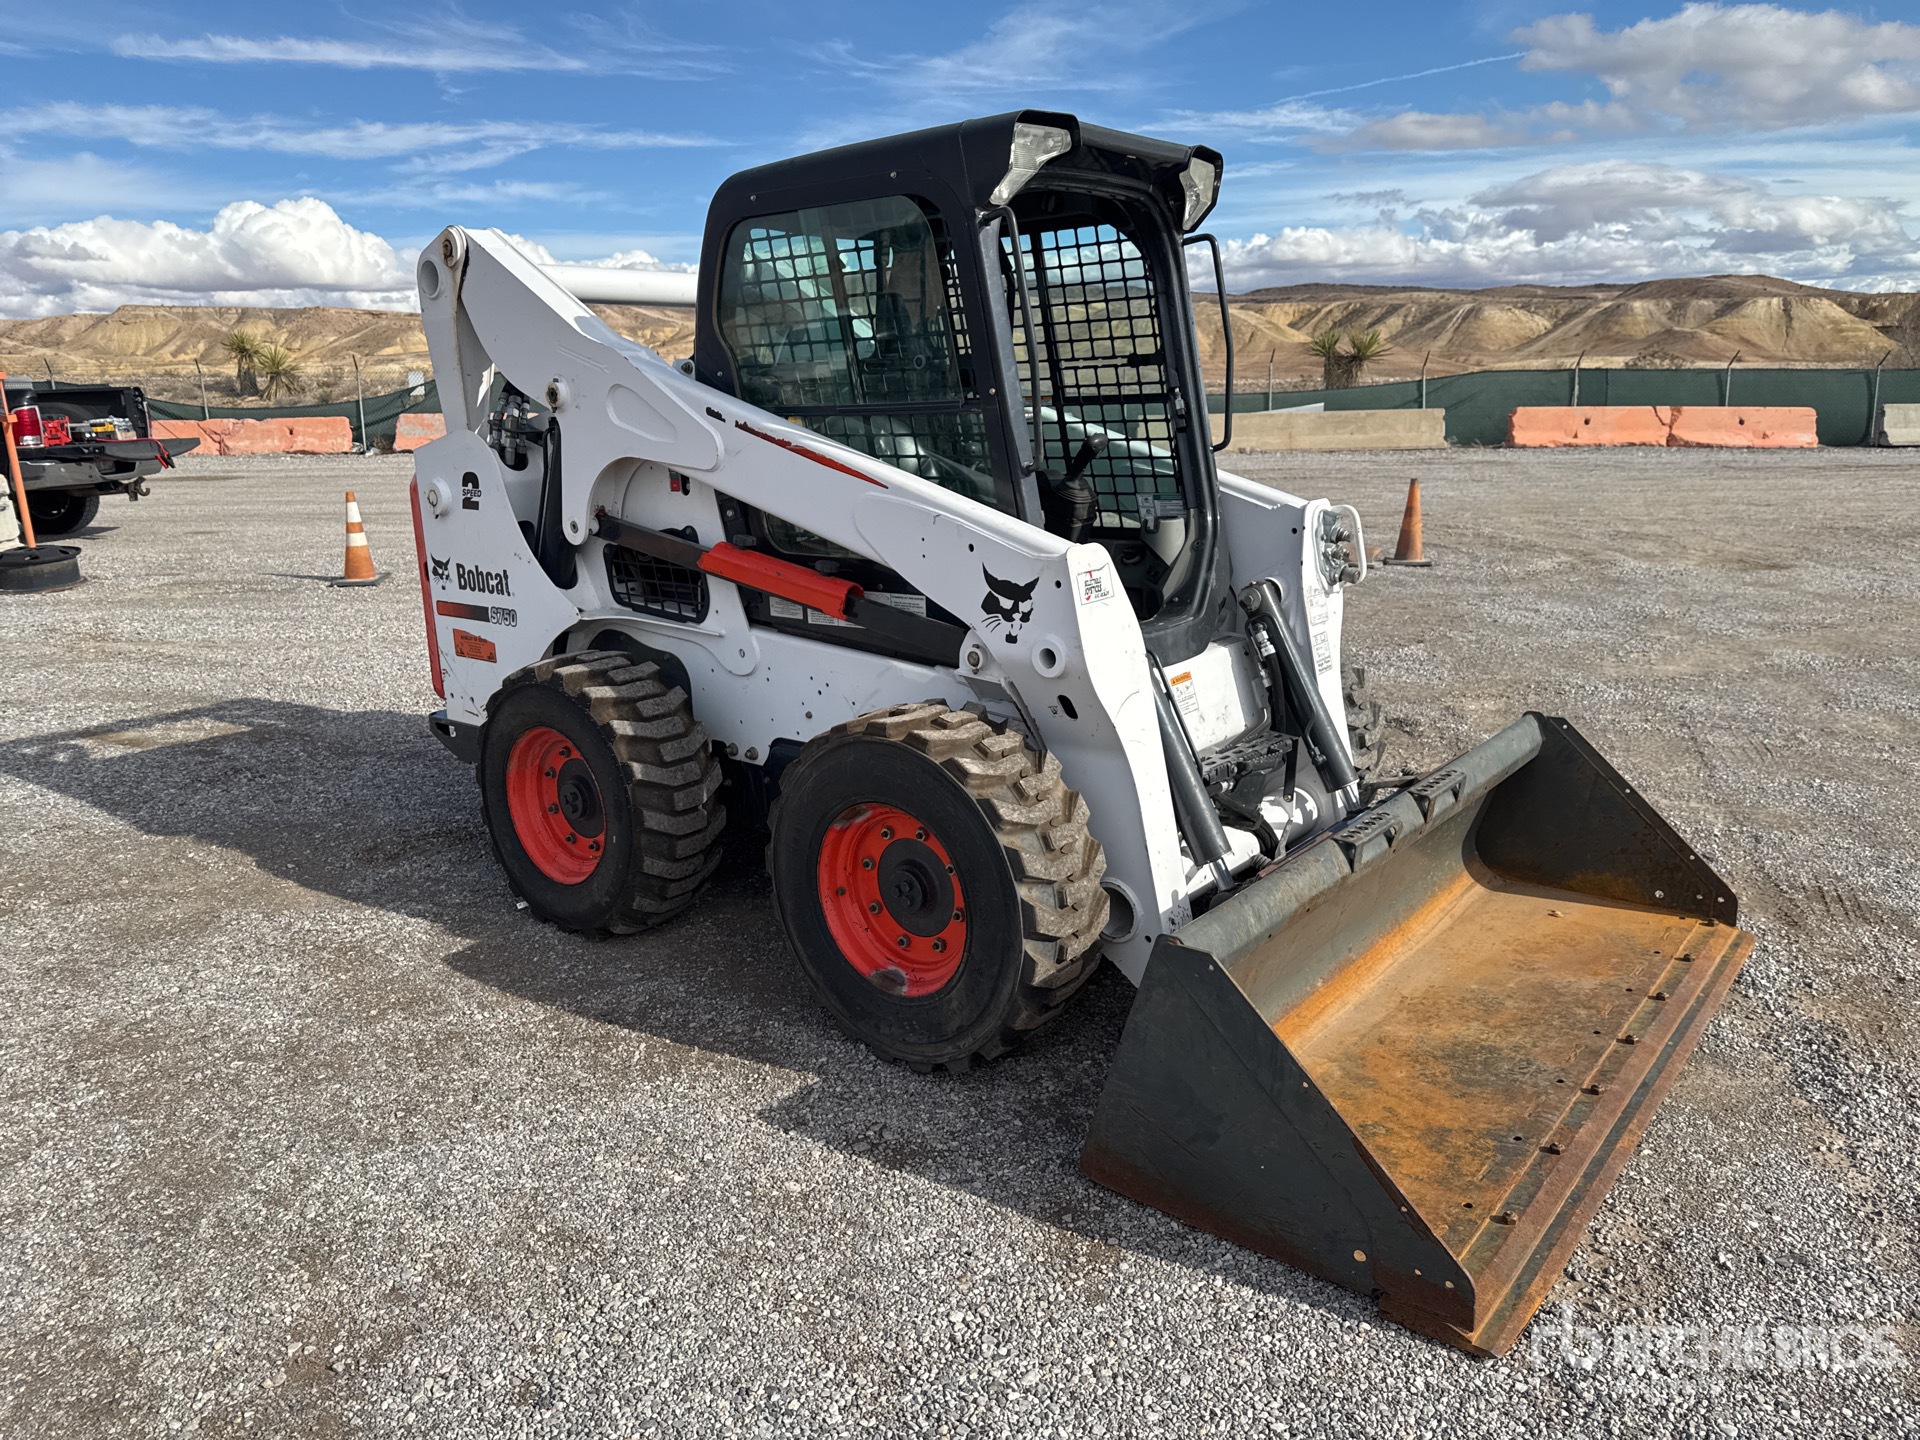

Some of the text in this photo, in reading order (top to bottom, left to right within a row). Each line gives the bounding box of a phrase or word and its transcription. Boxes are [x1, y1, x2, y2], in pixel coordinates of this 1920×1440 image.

[461, 471, 480, 511] 2
[462, 488, 482, 498] SPEED
[455, 562, 511, 597] Bobcat
[490, 606, 518, 628] S750
